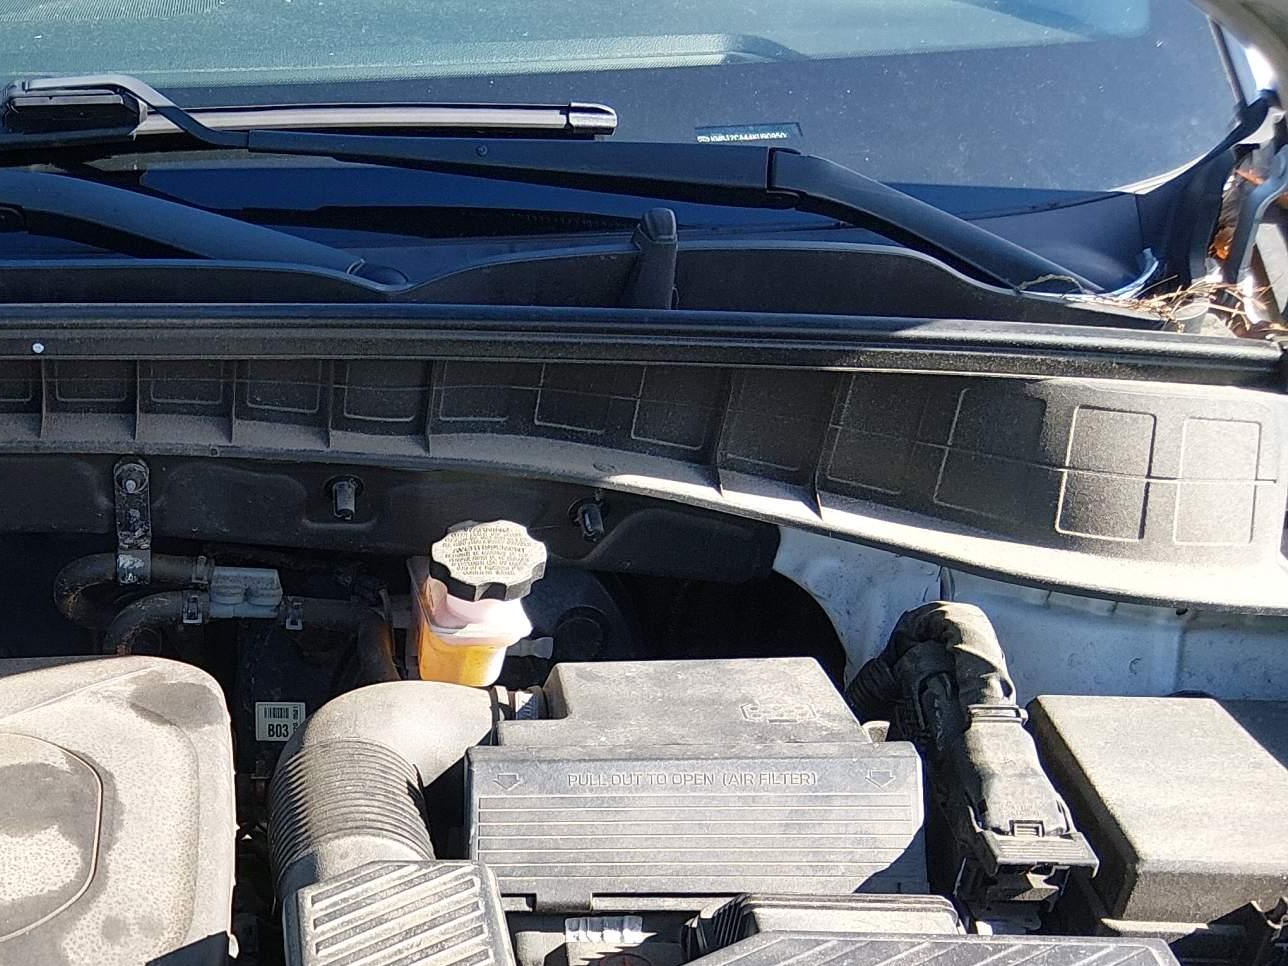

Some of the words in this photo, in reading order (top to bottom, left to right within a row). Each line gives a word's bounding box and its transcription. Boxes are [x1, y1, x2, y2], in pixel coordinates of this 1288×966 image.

[267, 723, 289, 738] B03
[568, 773, 607, 787] PULL
[612, 773, 643, 786] OUT
[647, 773, 667, 786] TO
[672, 772, 715, 786] OPEN
[722, 772, 754, 786] (AIR
[759, 772, 817, 786] FILTER)
